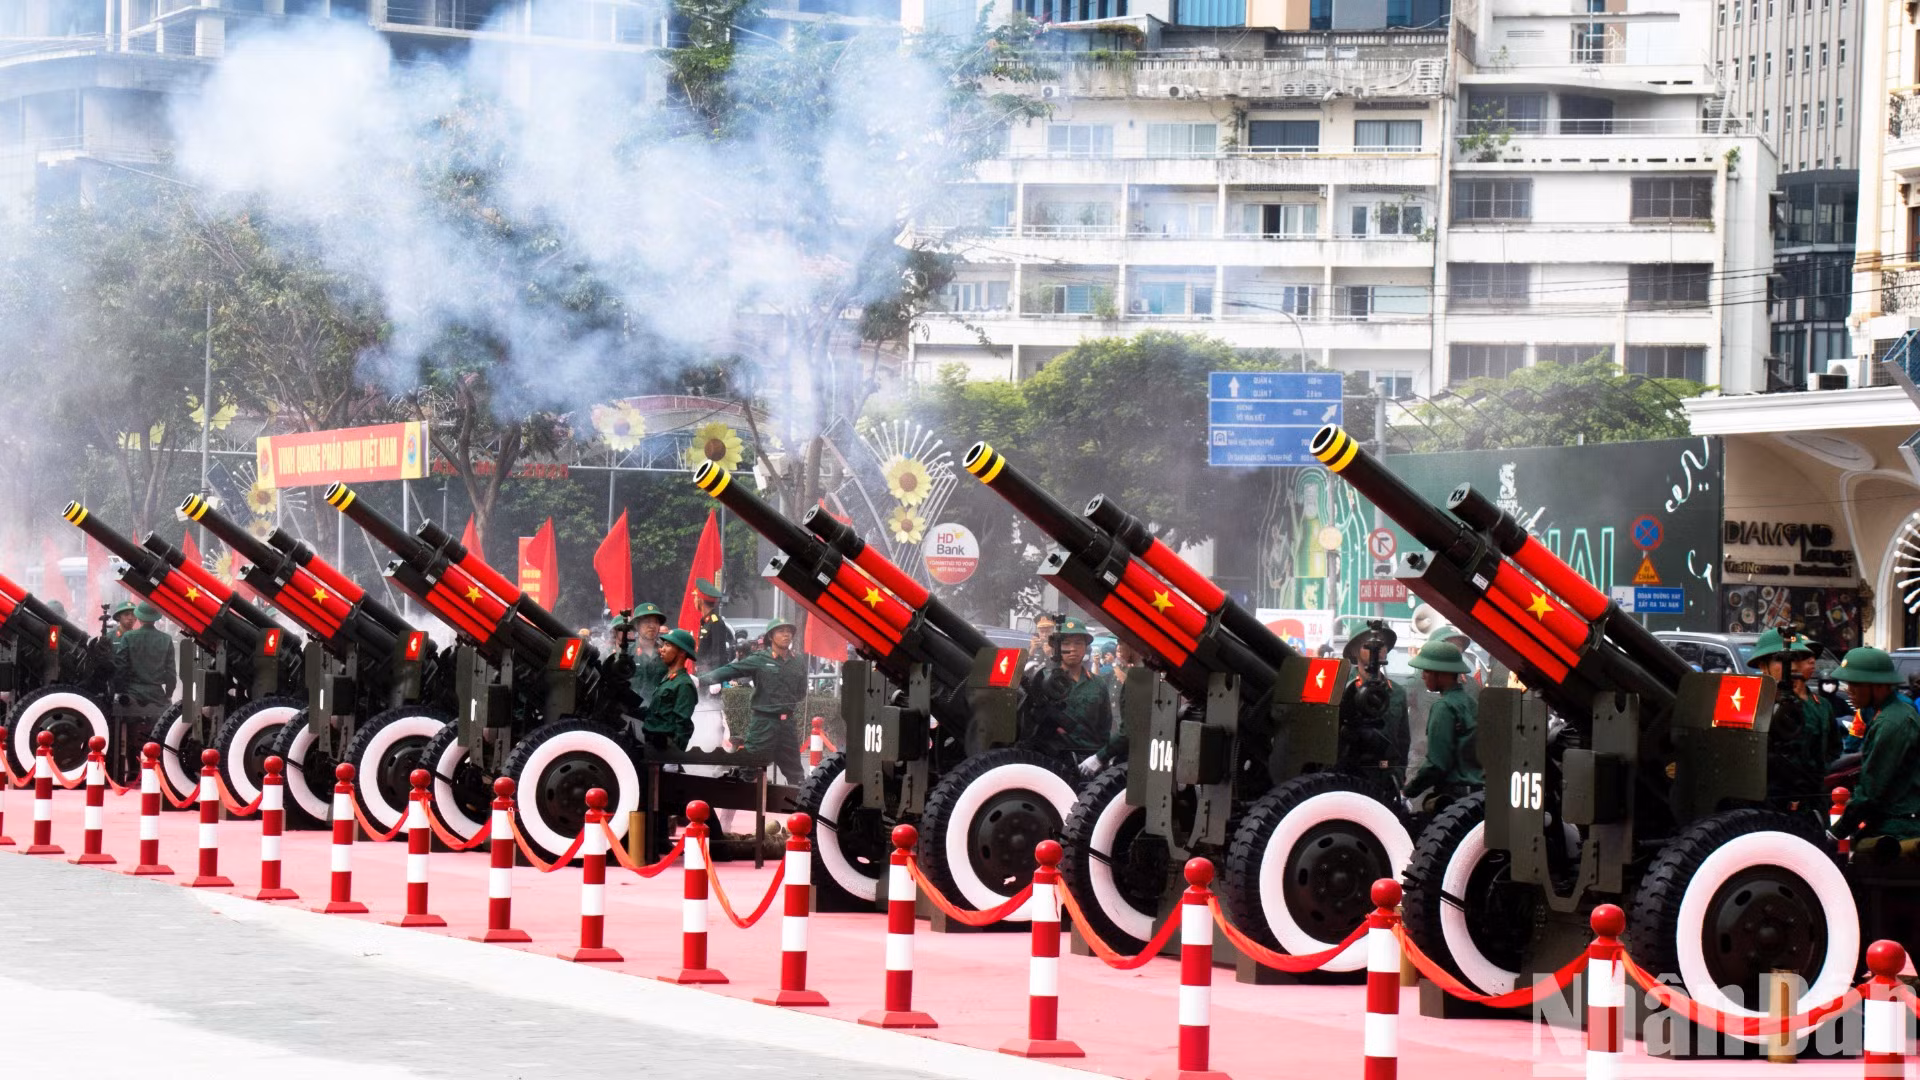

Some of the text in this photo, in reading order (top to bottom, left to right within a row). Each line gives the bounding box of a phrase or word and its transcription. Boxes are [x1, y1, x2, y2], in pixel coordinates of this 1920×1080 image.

[361, 432, 378, 475] VIỆT
[379, 437, 398, 466] NAM
[937, 532, 954, 544] HD
[1724, 520, 1834, 548] DIAMOND
[936, 544, 965, 555] Bank
[1380, 584, 1394, 598] QUAN
[864, 723, 883, 753] 013
[1149, 738, 1173, 772] 014
[1510, 771, 1542, 810] 015
